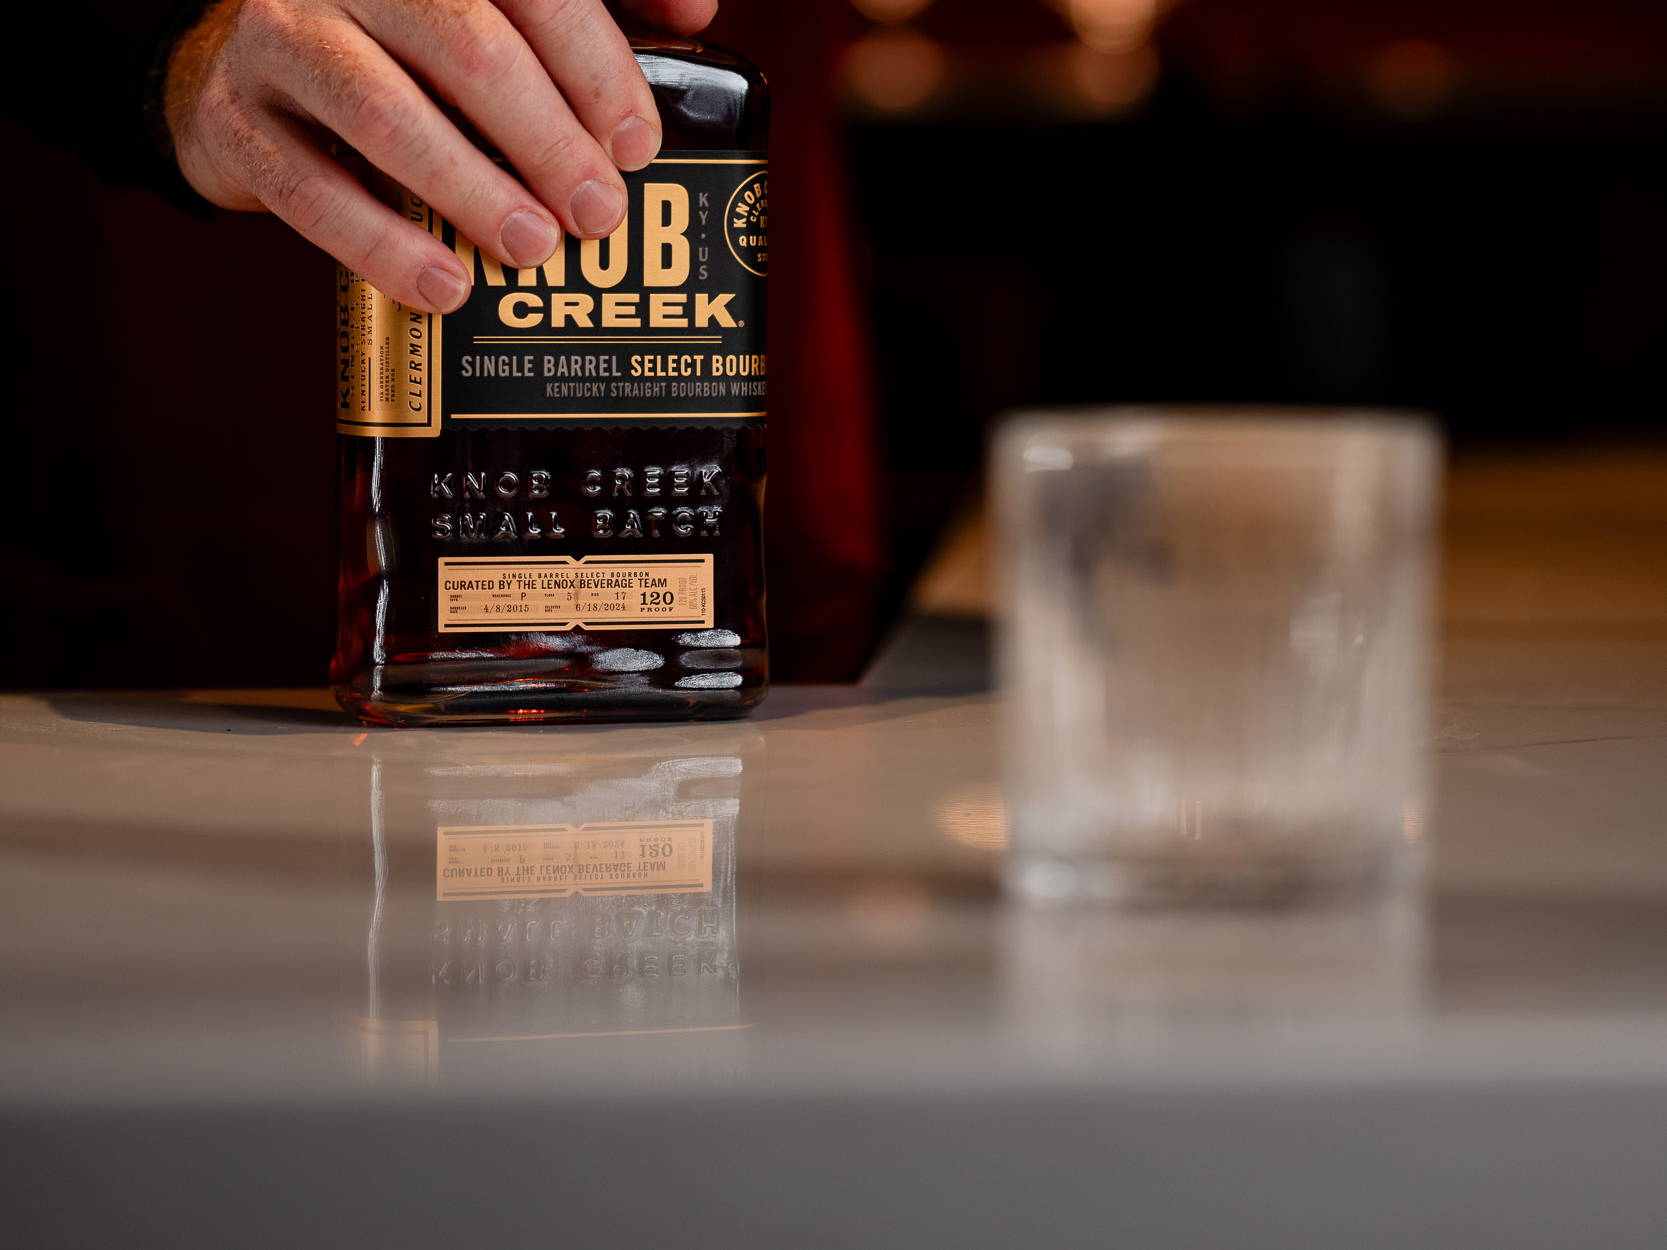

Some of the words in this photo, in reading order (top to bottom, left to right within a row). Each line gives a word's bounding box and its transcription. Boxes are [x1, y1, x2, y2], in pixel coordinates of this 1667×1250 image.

[733, 183, 762, 228] KNOB
[340, 303, 350, 410] KNOB
[409, 312, 423, 412] CLERMON
[461, 355, 534, 377] SINGLE
[543, 355, 622, 377] BARREL
[630, 355, 704, 377] SELECT
[546, 382, 606, 398] KENTUCKY
[610, 381, 667, 397] STRAIGHT
[671, 381, 726, 397] BOURBON
[430, 470, 552, 498] KNOB
[580, 464, 722, 497] CREEK
[431, 511, 566, 540] SMALL
[592, 505, 723, 539] BATCH
[444, 580, 495, 591] CURATED
[498, 580, 512, 590] BY
[516, 580, 537, 589] THE
[541, 579, 576, 589] LENOX
[580, 578, 634, 589] BEVERAGE
[638, 578, 668, 588] TEAM
[520, 592, 526, 601] P
[566, 592, 573, 601] 5
[615, 591, 627, 600] 17
[640, 591, 674, 605] 120
[483, 603, 530, 614] 4/8/2015
[575, 602, 626, 612] 6/18/2024
